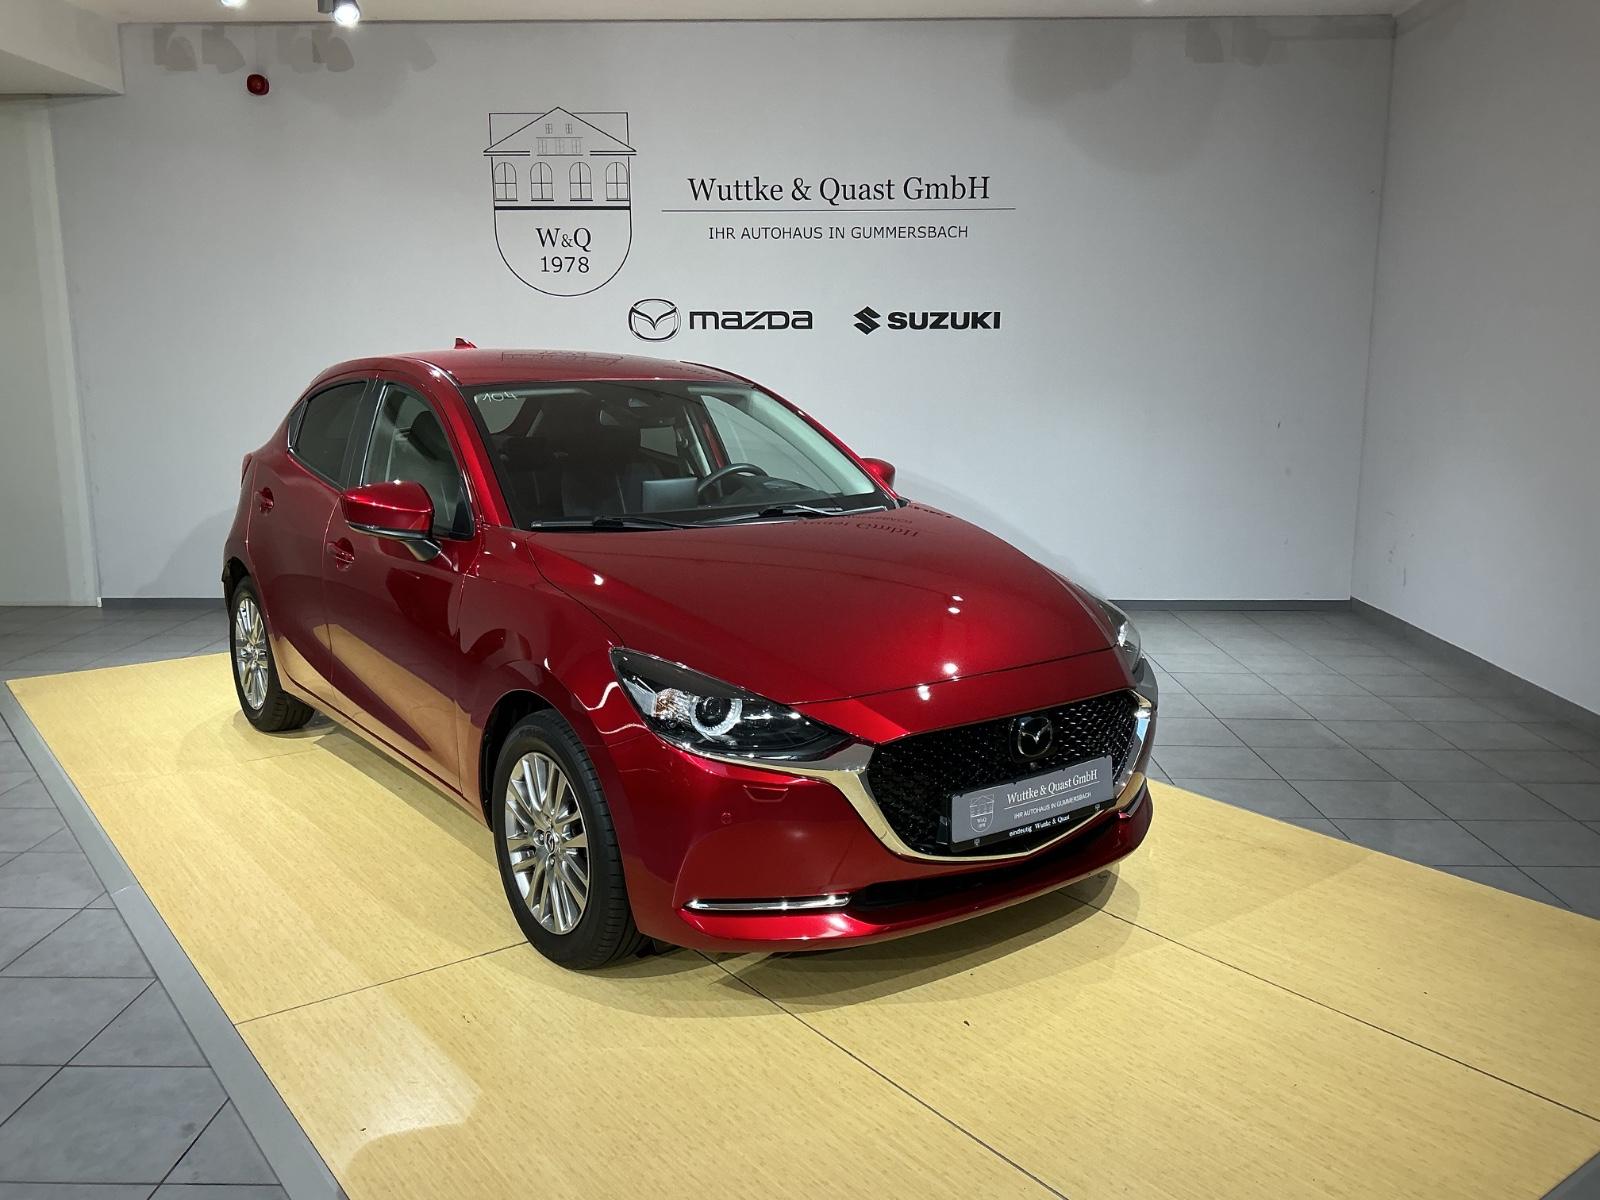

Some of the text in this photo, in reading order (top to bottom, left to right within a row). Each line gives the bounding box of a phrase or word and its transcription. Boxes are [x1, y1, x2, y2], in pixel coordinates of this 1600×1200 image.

[688, 175, 993, 207] Wuttke & Quast GmbH
[535, 227, 592, 252] W&Q
[708, 225, 969, 240] IHR AUTOHAUS IN GUMMERSBACH
[540, 256, 590, 274] 1978
[887, 311, 1001, 331] SUZUKI
[1007, 769, 1098, 804] Wuttke & Quast GmbH
[1013, 811, 1024, 820] IHR
[1024, 804, 1051, 818] AUTOHAUS
